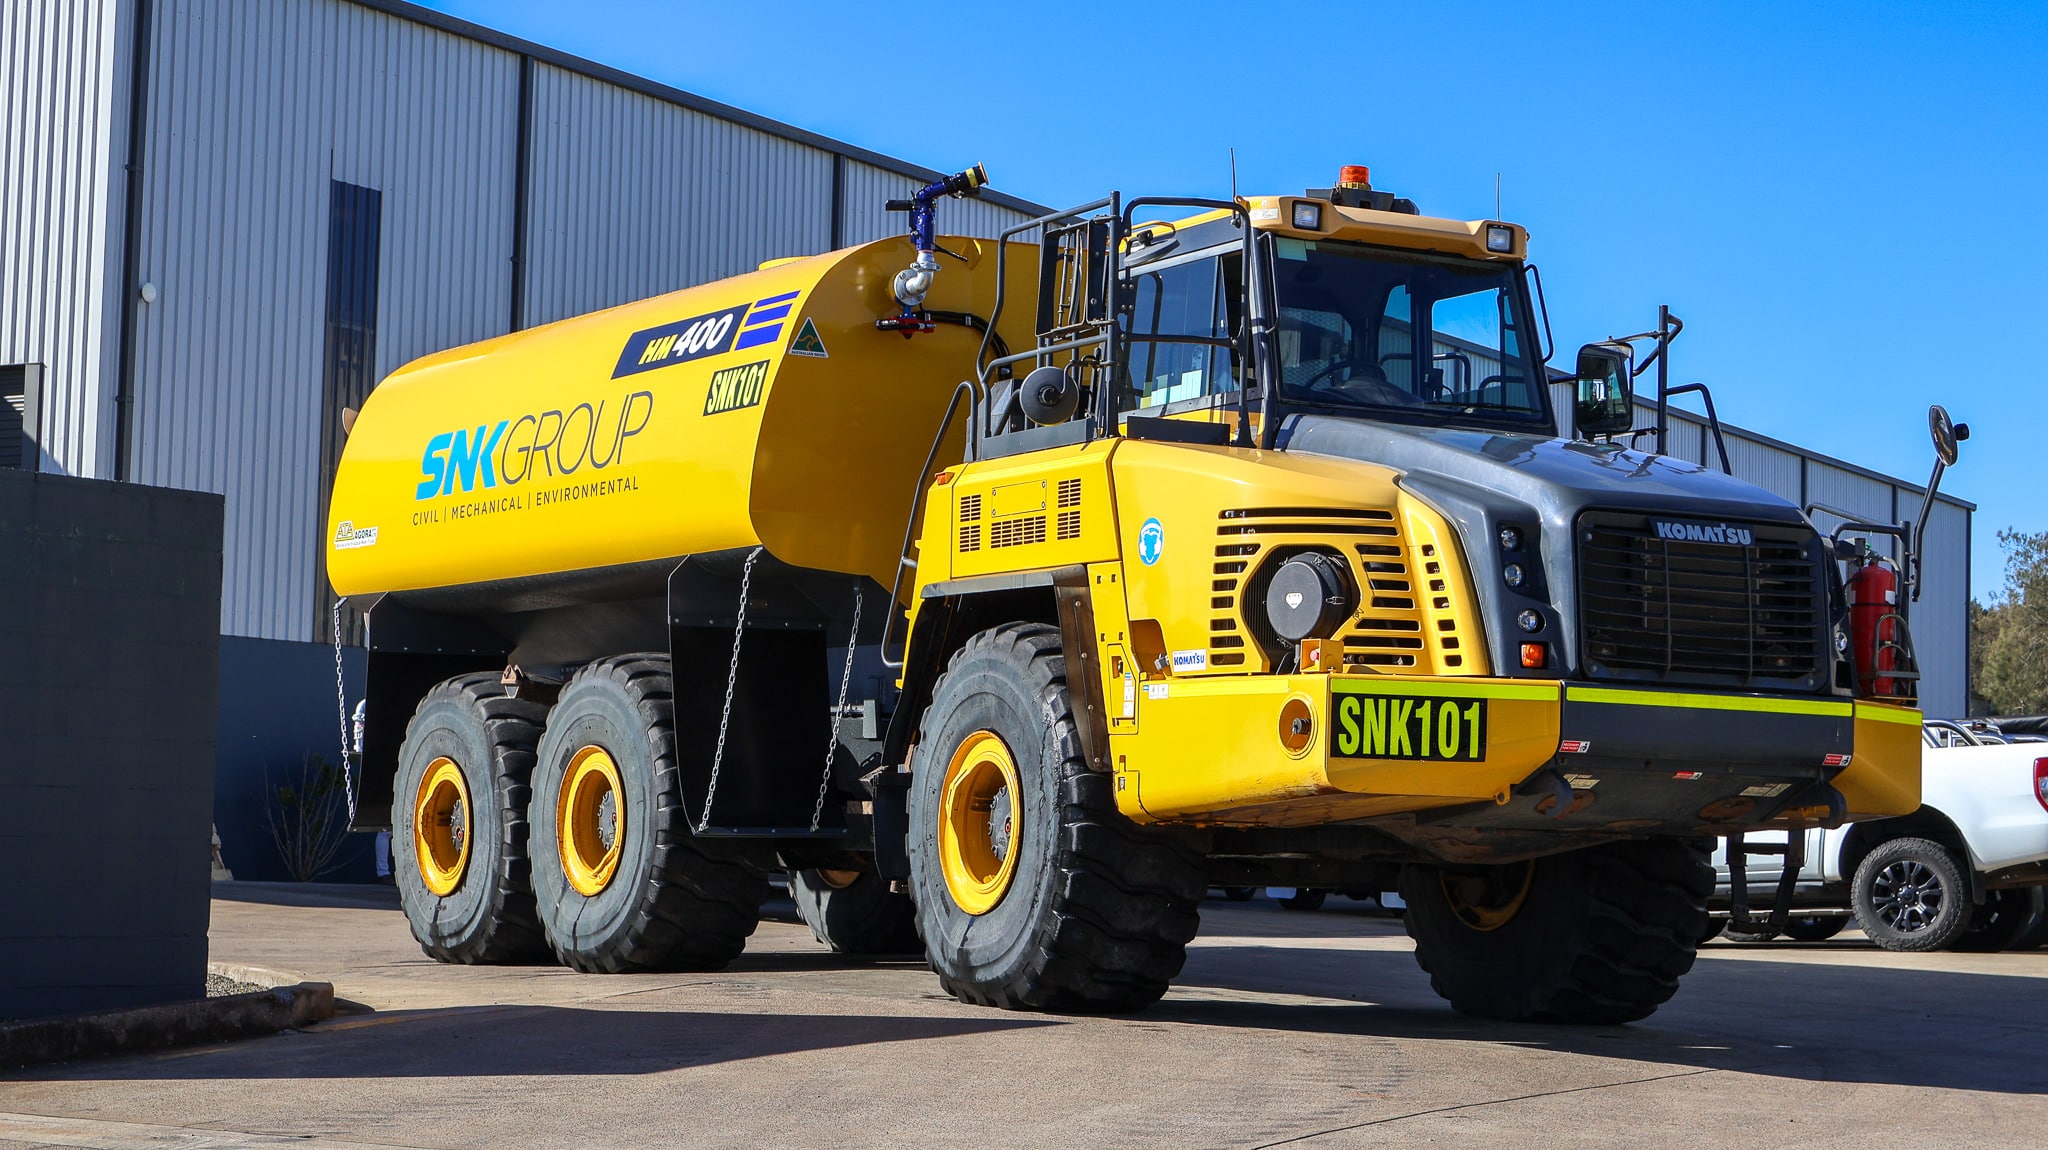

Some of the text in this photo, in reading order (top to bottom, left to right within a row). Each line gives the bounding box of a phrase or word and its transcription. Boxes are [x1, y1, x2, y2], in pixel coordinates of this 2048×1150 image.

[706, 362, 768, 414] SNK101
[412, 475, 639, 526] CIVIL MECHANICAL ENVIRONMENTAL
[1656, 522, 1752, 545] KOMATSU
[1173, 653, 1205, 666] KOMATSU
[1338, 696, 1480, 759] SNK101
